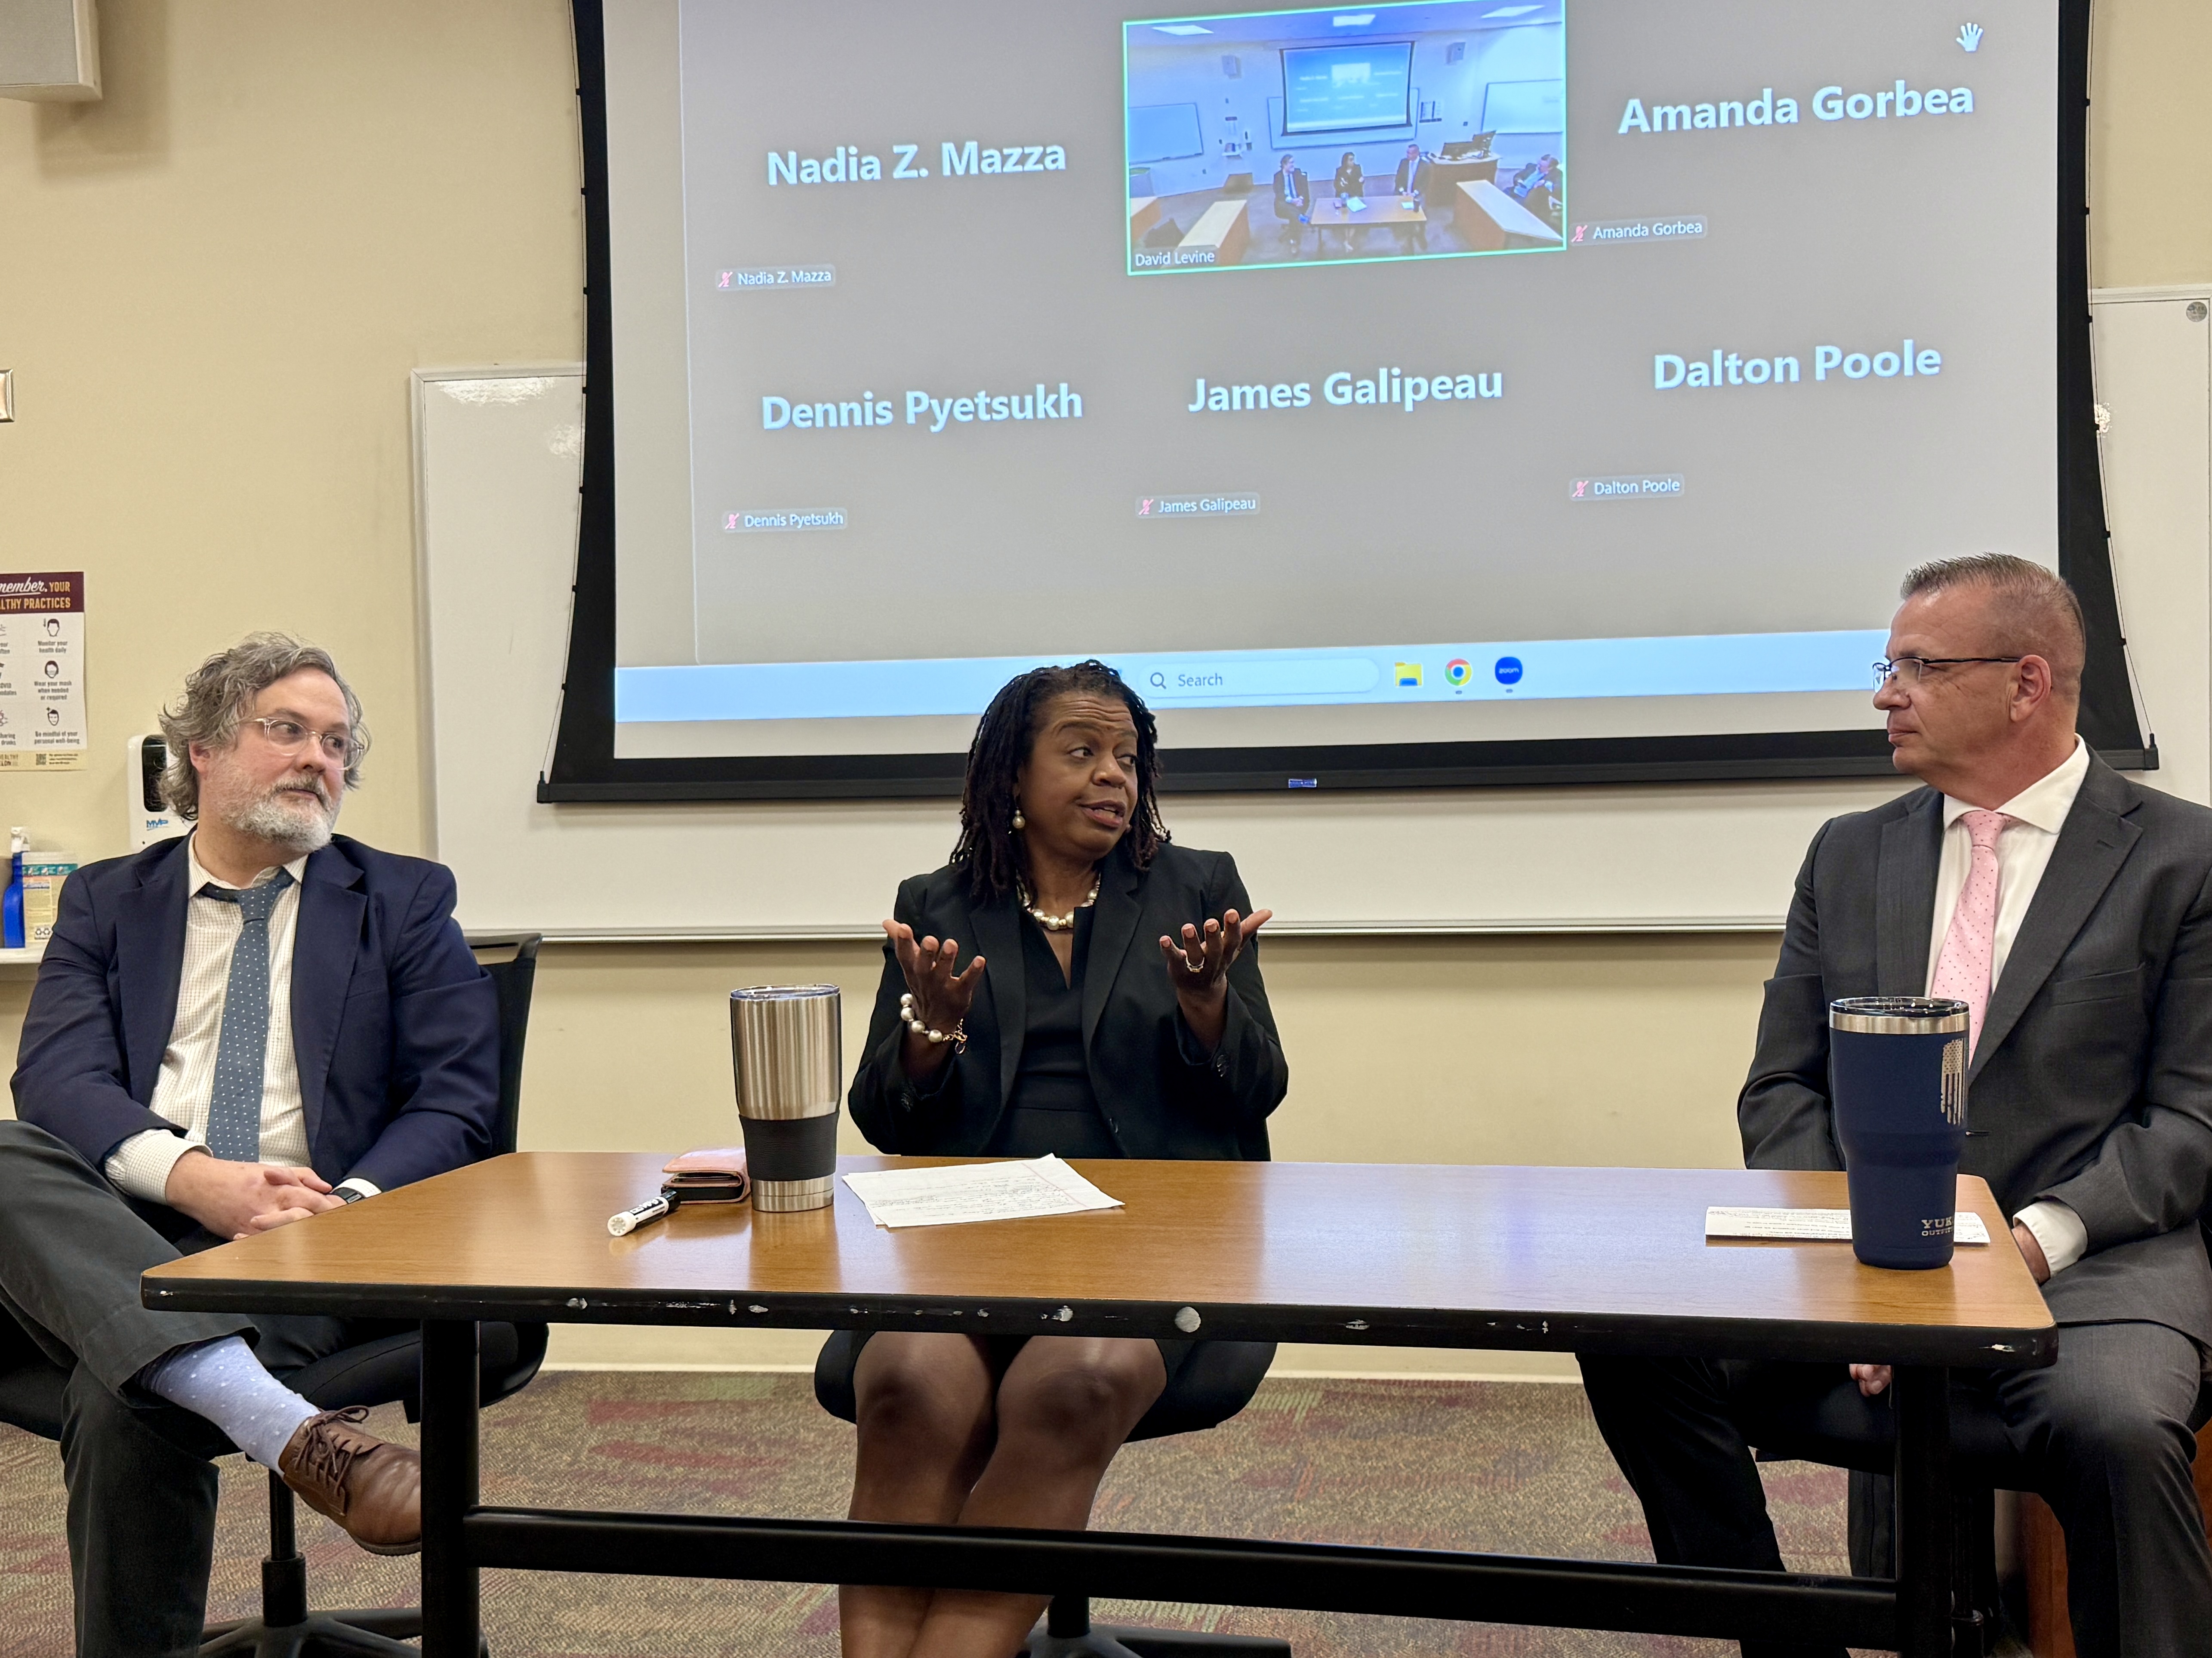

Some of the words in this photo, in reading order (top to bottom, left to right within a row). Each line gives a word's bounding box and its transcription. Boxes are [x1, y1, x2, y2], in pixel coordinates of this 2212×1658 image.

[1618, 88, 1798, 134] Amanda
[1812, 80, 1973, 120] Gorbea
[768, 145, 881, 185] Nadia
[893, 144, 929, 179] Z.
[942, 141, 1066, 176] Mazza
[1593, 223, 1649, 239] Amanda
[1652, 221, 1702, 235] Gorbea
[1135, 252, 1171, 266] David
[1174, 250, 1215, 264] Levine
[738, 271, 774, 285] Nadia
[777, 271, 789, 284] Z.
[792, 270, 832, 283] Mazza
[1654, 349, 1799, 389] Dalton
[1815, 339, 1941, 381] Poole
[1188, 379, 1311, 412] James
[1324, 367, 1502, 412] Galipeau
[762, 391, 893, 429] Dennis
[906, 382, 1082, 432] Pyetsukh
[1594, 481, 1639, 495] Dalton
[1642, 478, 1680, 493] Poole
[1158, 501, 1197, 513] James
[1200, 498, 1256, 513] Galipeau
[745, 514, 787, 527] Dennis
[789, 512, 843, 529] Pyetsukh
[49, 582, 70, 592] YOUR
[24, 597, 71, 609] PRACTICES
[1178, 673, 1223, 687] Search
[146, 818, 169, 828] MVP
